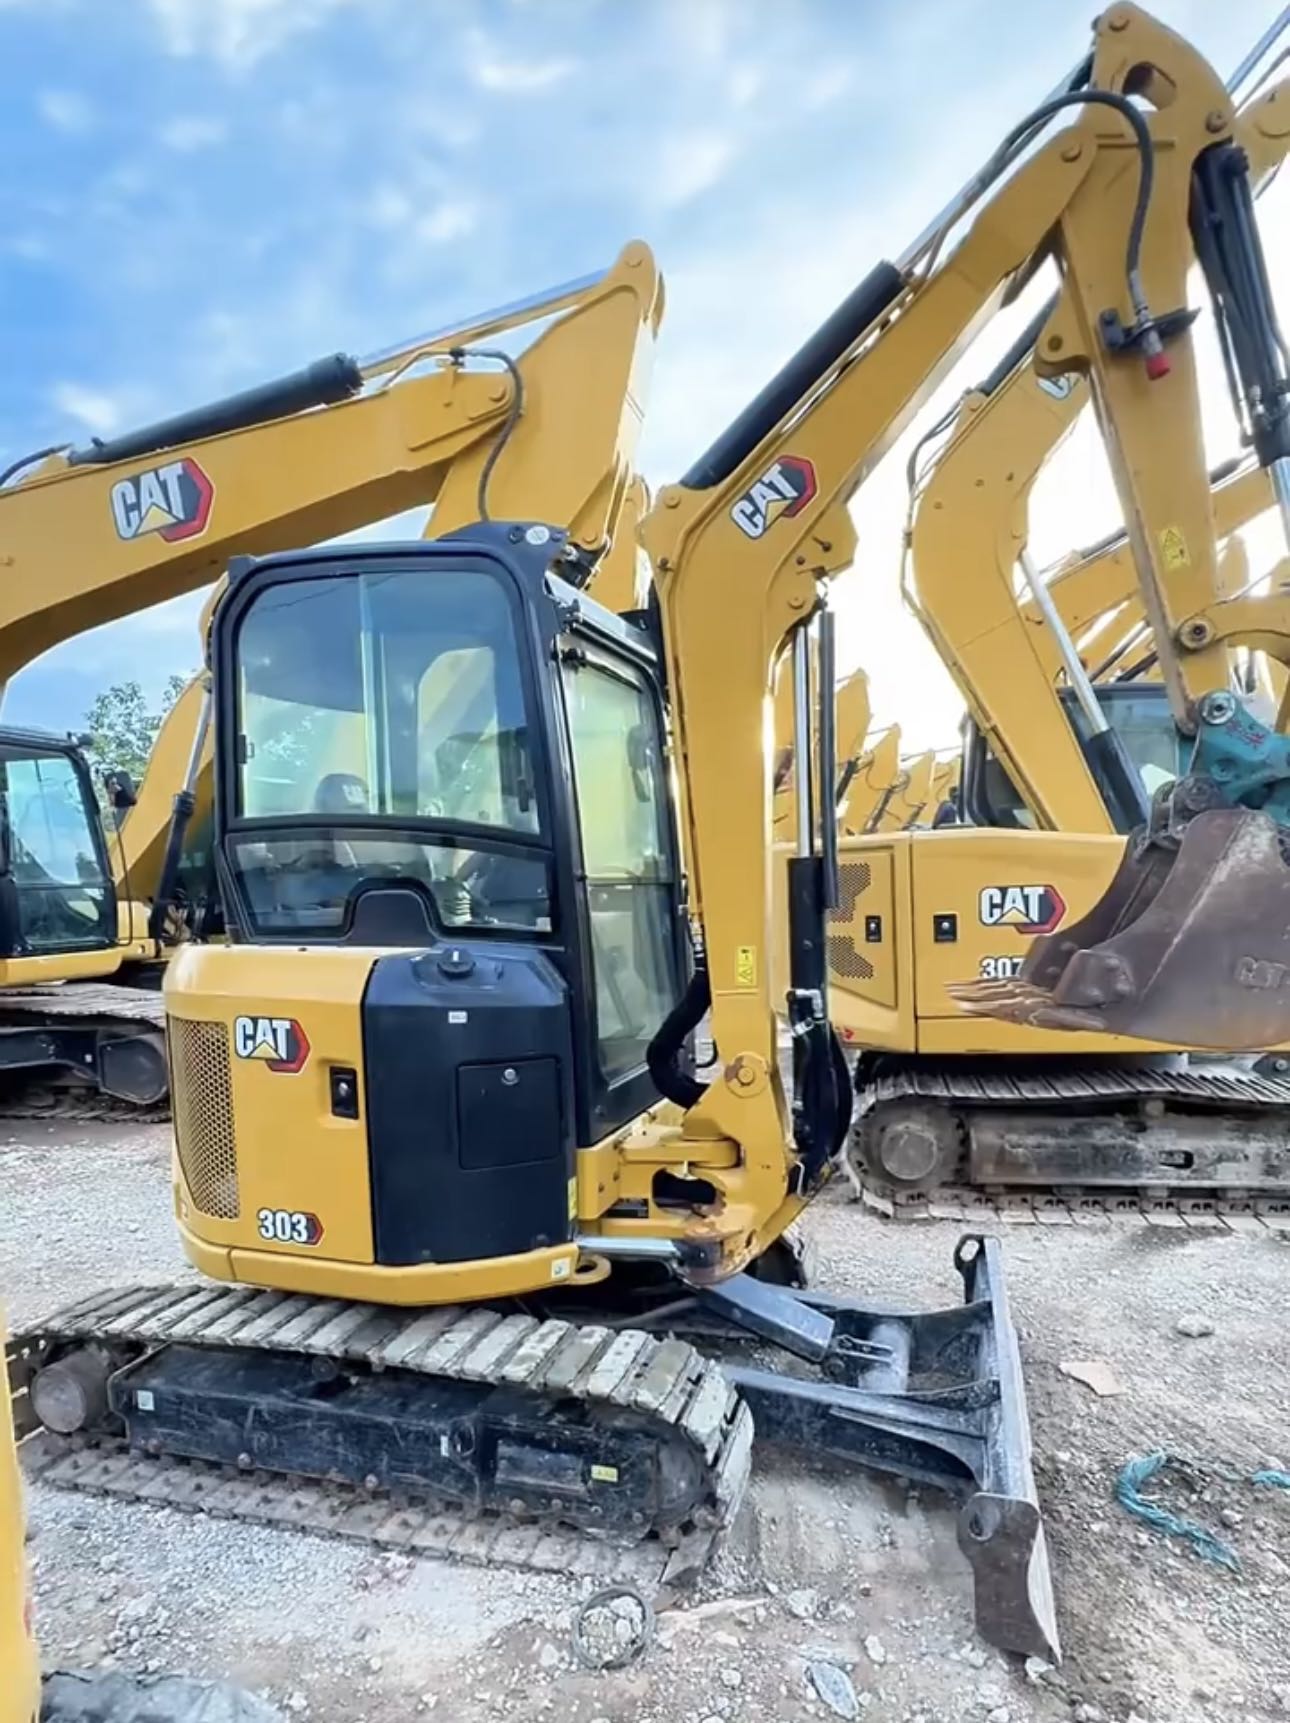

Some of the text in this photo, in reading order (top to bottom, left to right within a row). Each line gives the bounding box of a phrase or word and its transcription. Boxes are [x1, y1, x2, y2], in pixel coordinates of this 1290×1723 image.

[111, 462, 186, 540] CAT
[730, 463, 800, 539] CAT
[980, 886, 1045, 925] CAT
[980, 957, 1026, 979] 307
[235, 1016, 291, 1060] CAT
[257, 1209, 308, 1243] 303
